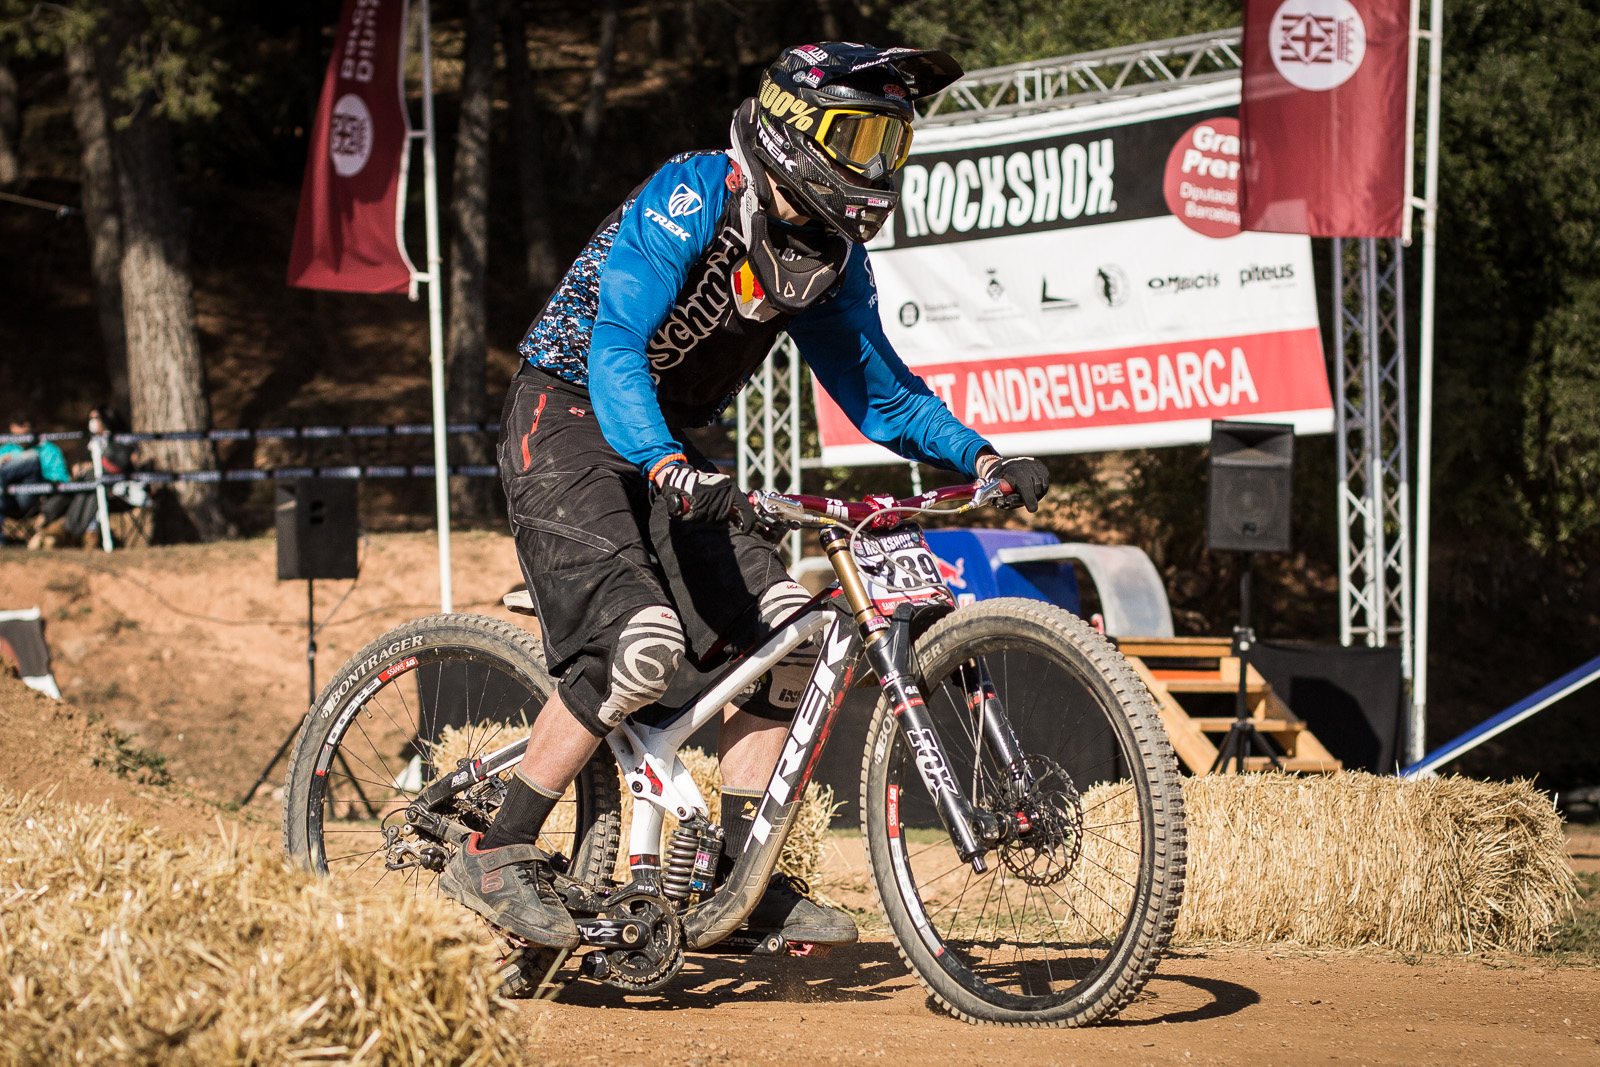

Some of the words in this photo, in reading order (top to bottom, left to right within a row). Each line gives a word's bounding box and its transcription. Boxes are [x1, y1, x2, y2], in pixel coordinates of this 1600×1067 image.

[759, 74, 818, 132] 100%
[756, 113, 798, 173] TREK
[1192, 125, 1241, 156] Gra
[902, 138, 1115, 237] ROCKSHOX
[643, 207, 692, 243] TREK
[1240, 263, 1294, 287] piteus
[964, 362, 1097, 426] ANDREU
[1091, 363, 1125, 386] DE
[1126, 347, 1260, 413] BARCA
[1097, 389, 1131, 412] LA
[330, 635, 424, 706] BONTRAGER
[743, 619, 853, 854] TREK
[906, 728, 959, 806] FOX
